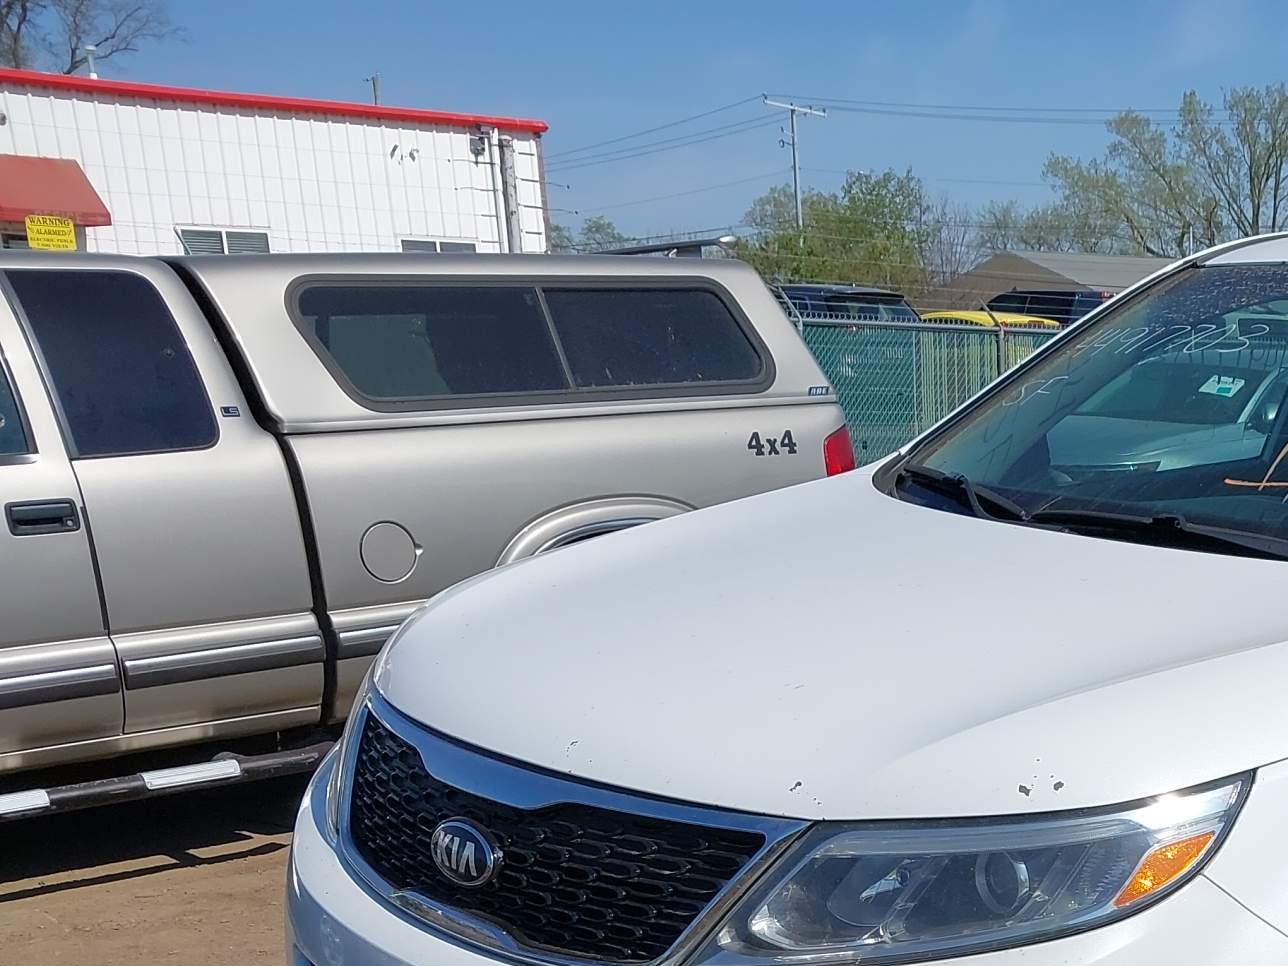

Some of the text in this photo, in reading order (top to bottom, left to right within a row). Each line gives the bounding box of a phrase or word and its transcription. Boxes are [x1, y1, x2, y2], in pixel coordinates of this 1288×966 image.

[28, 216, 70, 226] WARNING
[35, 228, 67, 236] ALARMED
[221, 407, 239, 415] LS
[747, 429, 797, 456] 4x4
[436, 829, 477, 877] KIA
